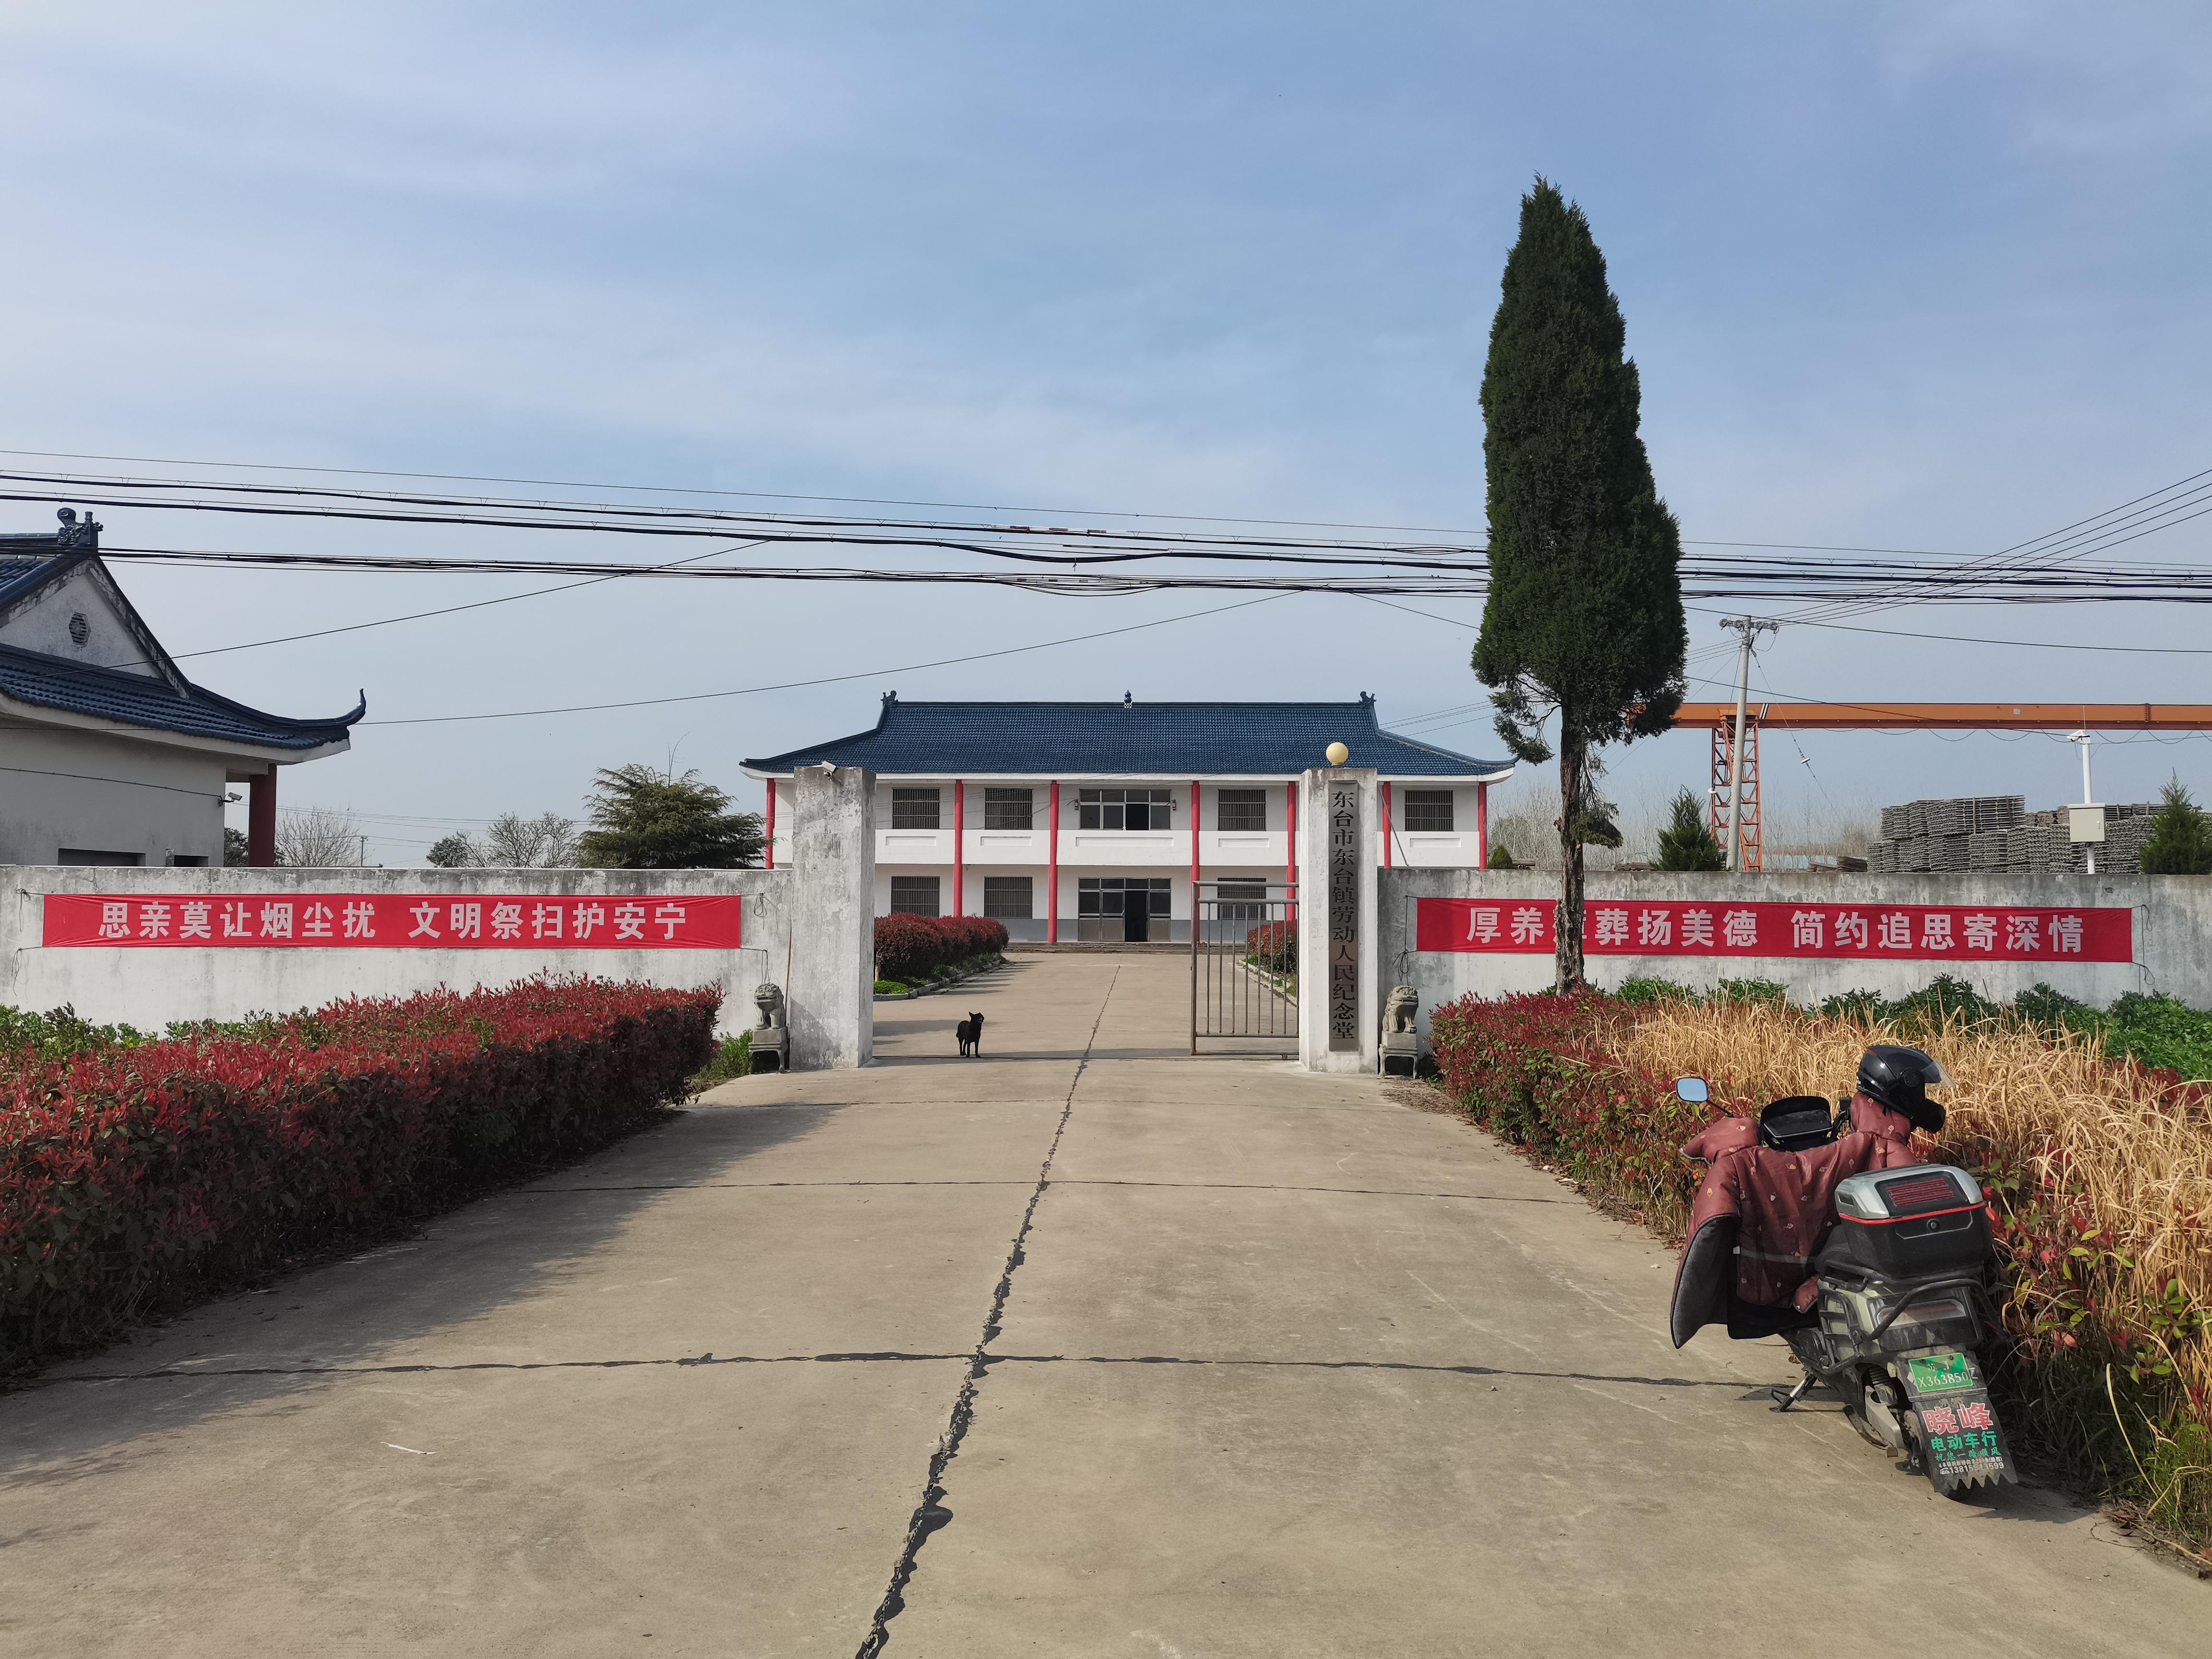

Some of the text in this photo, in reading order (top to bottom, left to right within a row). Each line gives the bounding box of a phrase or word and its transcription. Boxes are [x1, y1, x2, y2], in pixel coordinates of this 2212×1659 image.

[98, 902, 685, 939] 思亲莫让烟尘扰 文明祭扫护安宁
[1332, 791, 1355, 1039] 东台市东台镇劳动人民纪念堂
[1467, 907, 2084, 952] 厚养葬扬美德 简约追思寄深情
[1917, 1372, 1969, 1387] X363850
[1922, 1402, 1994, 1435] 晓峰
[1931, 1431, 1996, 1452] 电动车行
